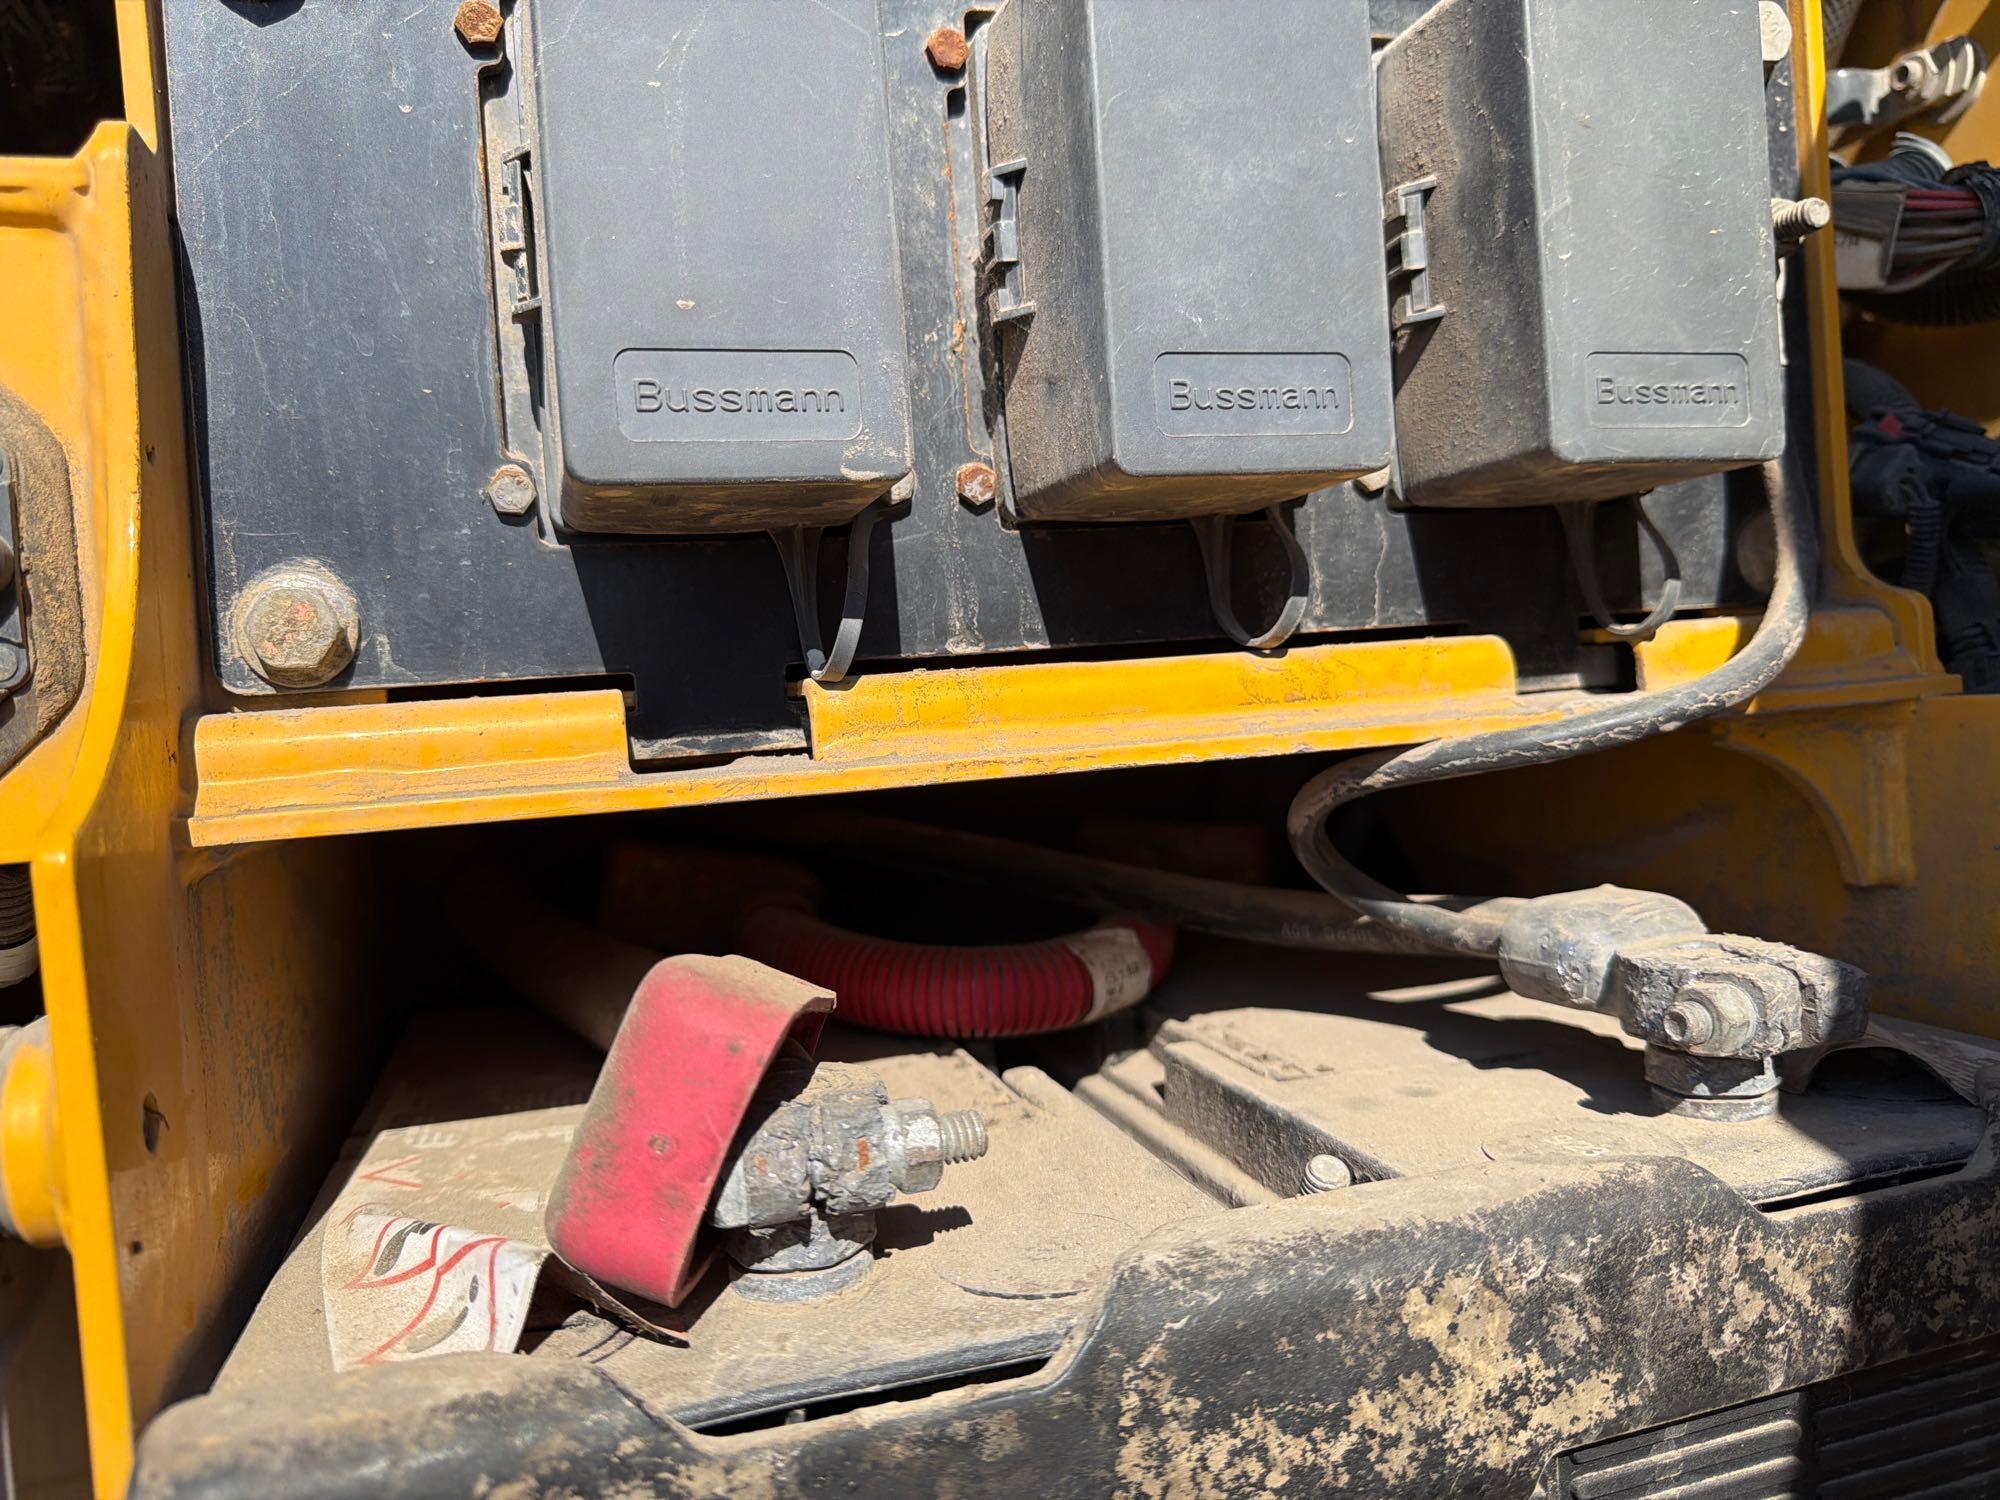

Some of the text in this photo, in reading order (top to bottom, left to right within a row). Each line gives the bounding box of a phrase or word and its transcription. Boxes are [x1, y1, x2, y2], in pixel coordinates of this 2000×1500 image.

[633, 377, 845, 414] Bussmann
[1168, 378, 1339, 411] Bussmann
[1596, 376, 1739, 405] Bussmann
